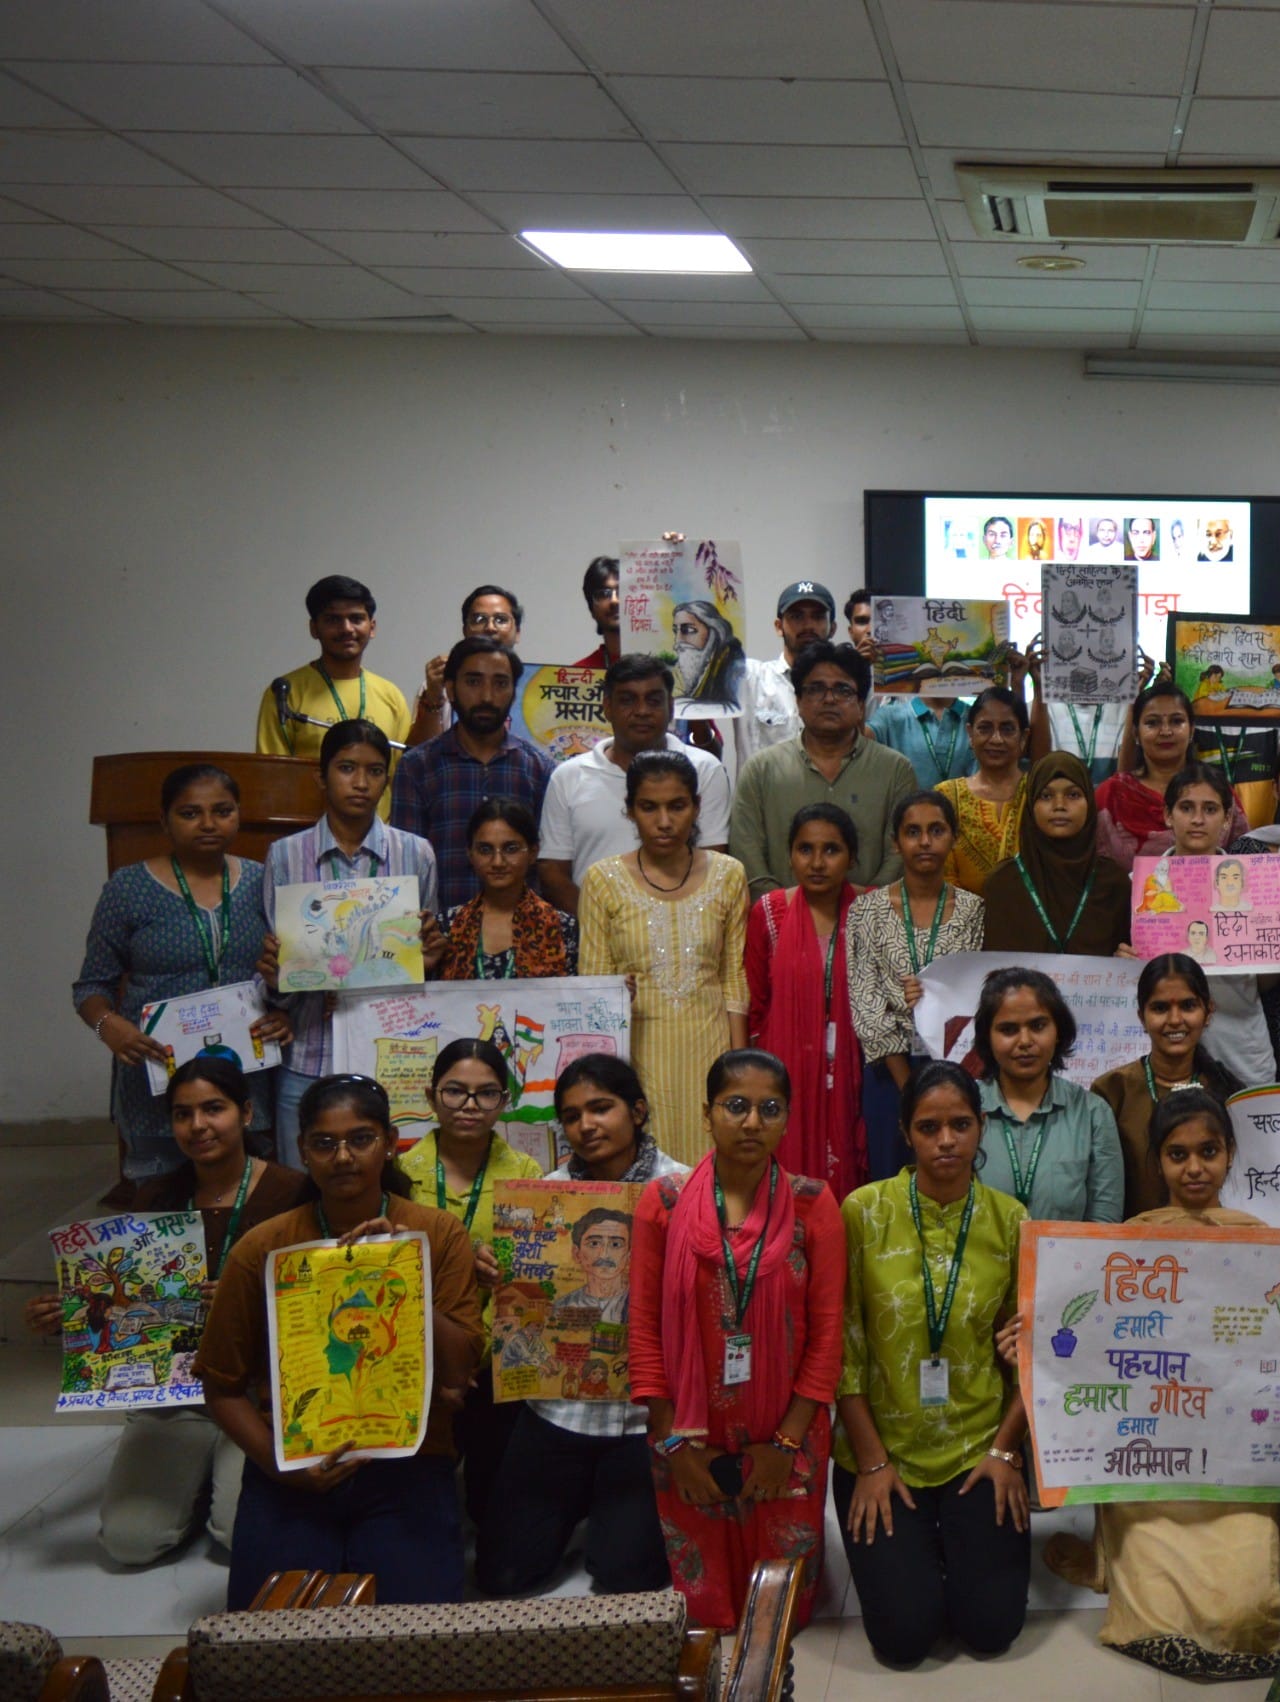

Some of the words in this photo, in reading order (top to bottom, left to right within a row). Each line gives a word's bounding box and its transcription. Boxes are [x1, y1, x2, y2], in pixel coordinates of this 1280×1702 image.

[922, 600, 967, 623] हिंदी
[554, 668, 595, 685] हिन्दी
[540, 685, 579, 701] प्रचार
[582, 678, 605, 702] औ
[555, 701, 606, 723] प्रसार
[1223, 943, 1280, 963] रचनाकार
[50, 1220, 99, 1257] हिंदी
[91, 1213, 146, 1243] प्रचार
[148, 1210, 197, 1239] प्रसार
[1101, 1251, 1188, 1304] हिंदी
[1114, 1310, 1173, 1339] हमारी
[1104, 1348, 1191, 1382] पहचान
[1063, 1383, 1134, 1417] हमारा
[1150, 1377, 1213, 1419] गौरव
[1116, 1416, 1160, 1437] हमारा
[1103, 1438, 1193, 1478] अभिमान
